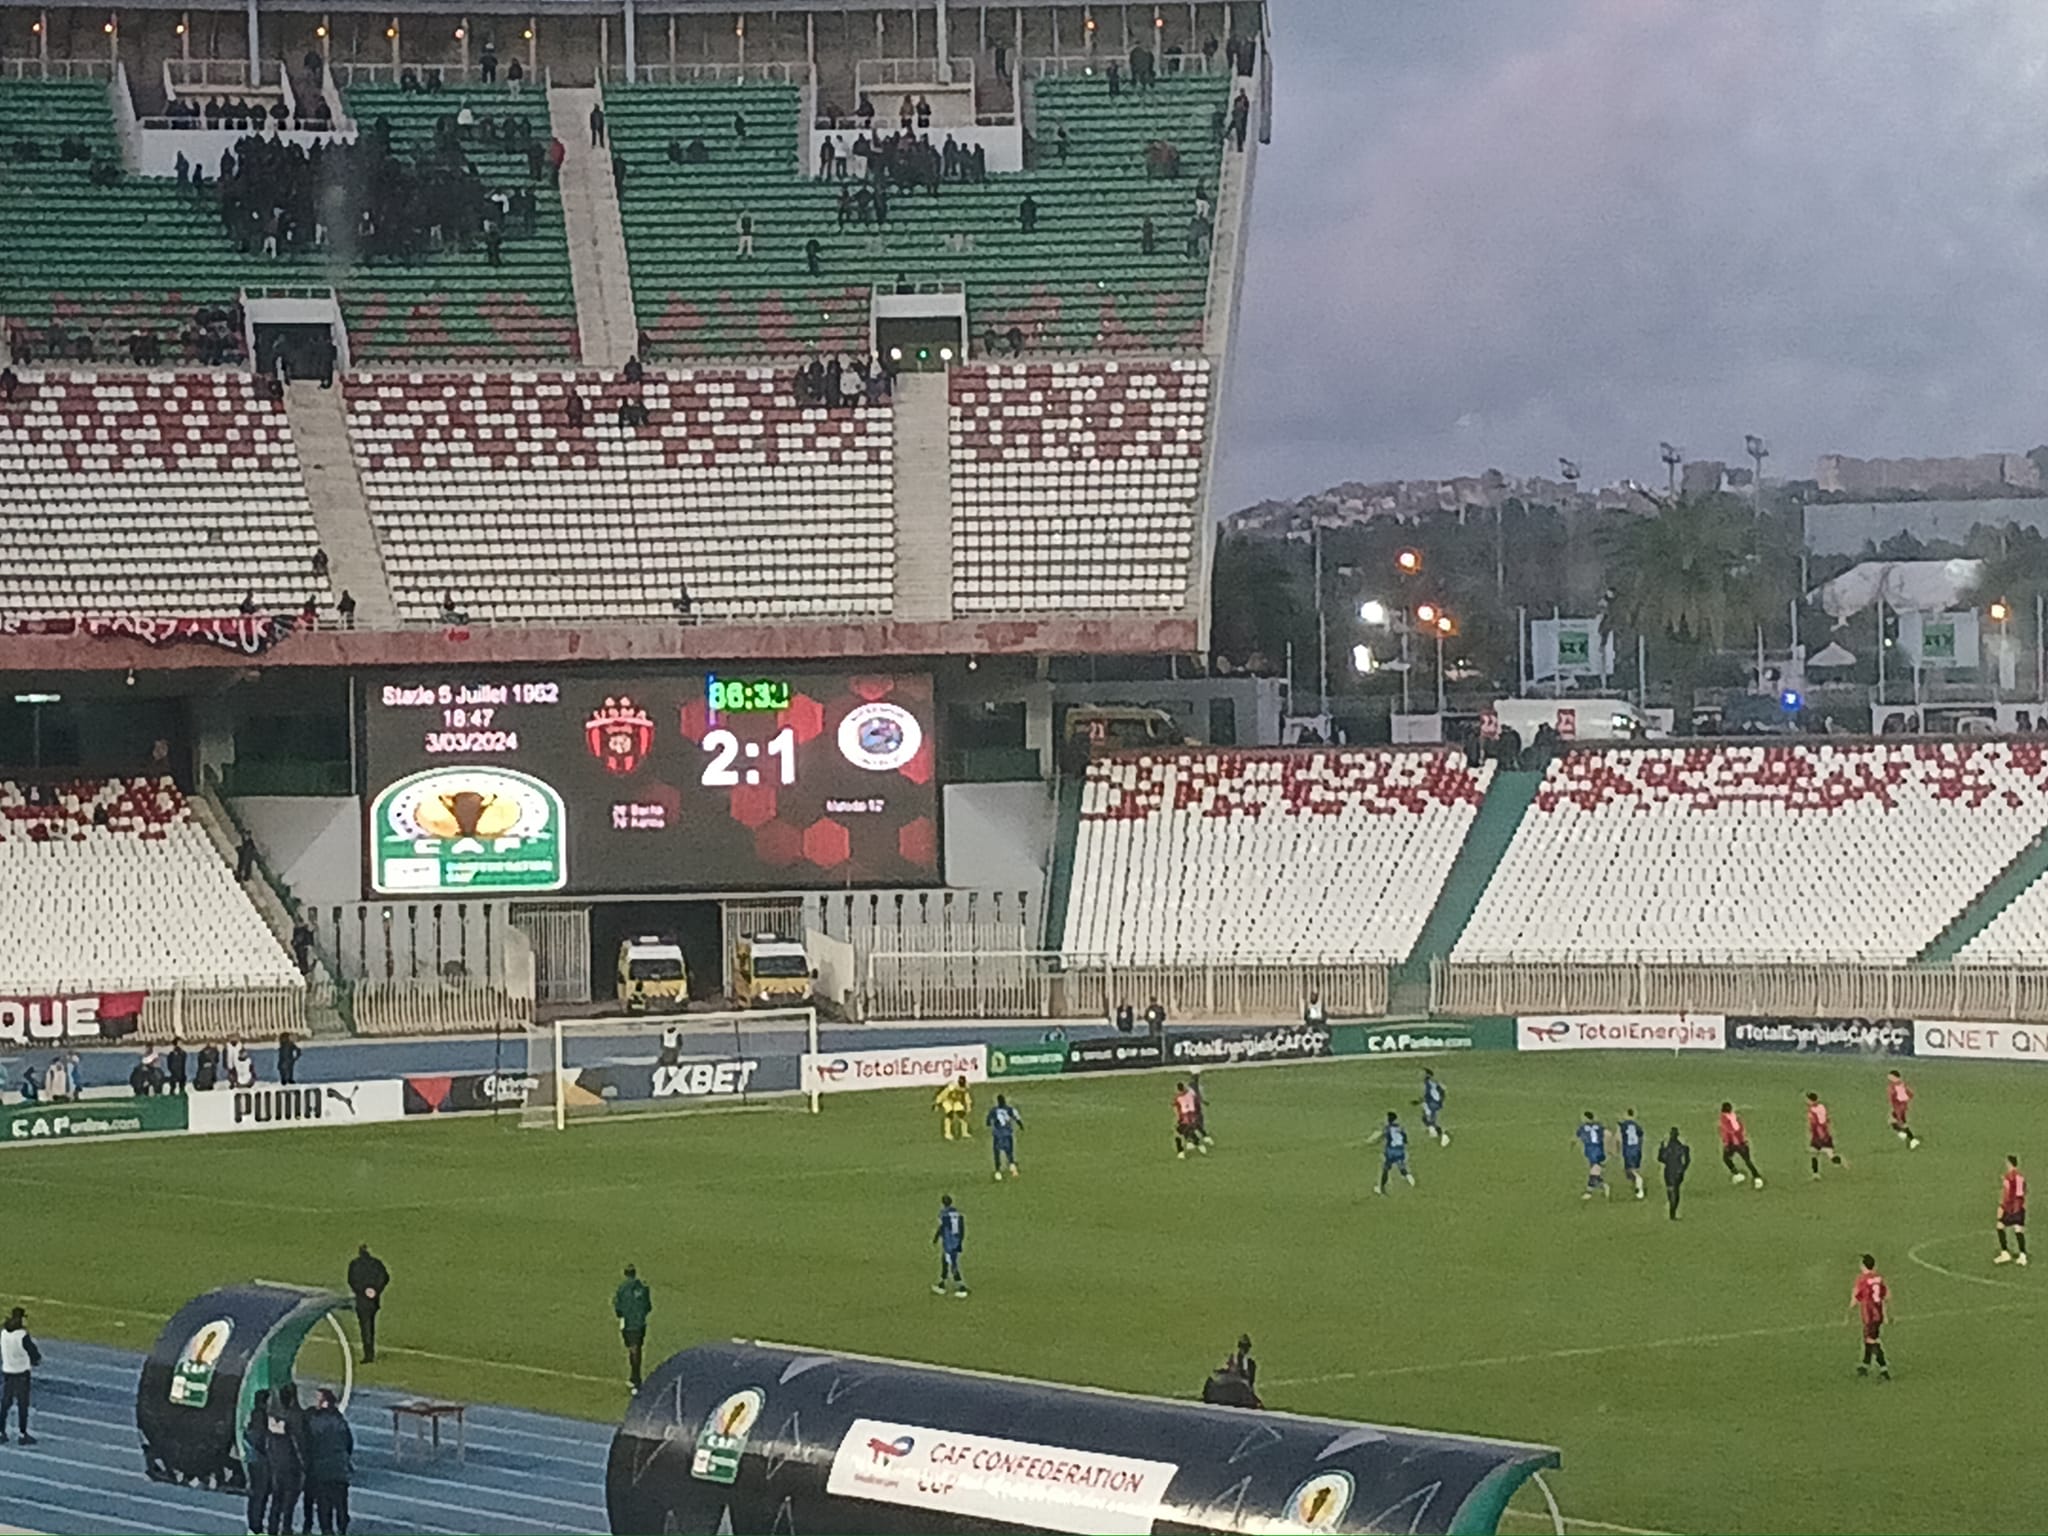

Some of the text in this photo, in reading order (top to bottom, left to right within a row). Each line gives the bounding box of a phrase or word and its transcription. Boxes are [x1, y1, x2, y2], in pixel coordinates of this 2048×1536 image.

[425, 731, 517, 752] 3/03/2024
[701, 727, 796, 786] 2:1
[1577, 1022, 1716, 1045] TotalEnergies
[1925, 1027, 1999, 1050] QNET
[652, 1060, 759, 1098] 1XBET
[854, 1054, 979, 1078] TotalEnergies
[234, 1087, 322, 1123] PUMA
[973, 1448, 1144, 1496] CONFEDERATION
